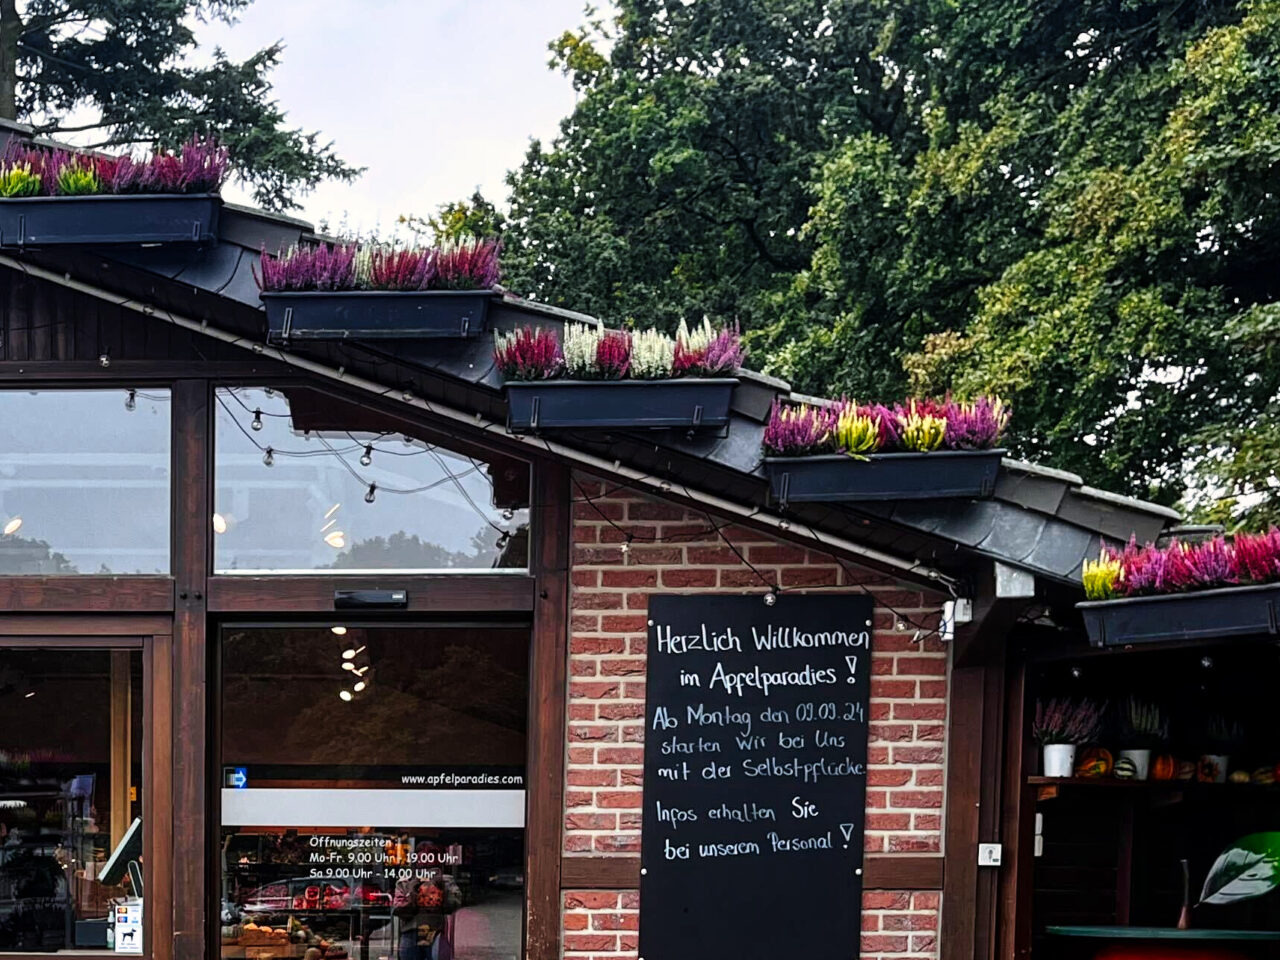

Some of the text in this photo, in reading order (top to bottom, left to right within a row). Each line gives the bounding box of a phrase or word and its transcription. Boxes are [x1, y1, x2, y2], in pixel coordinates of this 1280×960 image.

[656, 623, 869, 654] Herzlich Willkommen
[680, 670, 700, 687] im
[709, 662, 836, 696] Apfelparadies
[653, 702, 863, 737] Ab Montag den 09.09.24
[661, 737, 720, 754] starten
[779, 732, 804, 749] bei
[816, 730, 845, 747] Uns
[401, 773, 523, 786] www.apfelparadies.com
[658, 763, 690, 780] mit
[702, 762, 731, 779] der
[657, 796, 819, 829] Infos erhalten Sie
[309, 835, 392, 849] Öffnungszeiten
[664, 839, 690, 860] bei
[699, 841, 759, 856] unserem
[767, 832, 833, 852] Personal
[309, 852, 345, 863] Mo-Fr.
[348, 852, 372, 863] 9.00
[407, 852, 435, 863] 19.00
[438, 852, 458, 863] Uhr
[309, 868, 323, 879] Sa
[326, 868, 350, 879] 9.00
[352, 868, 373, 879] Uhr
[384, 868, 412, 879] 14.00
[416, 868, 436, 879] Uhr
